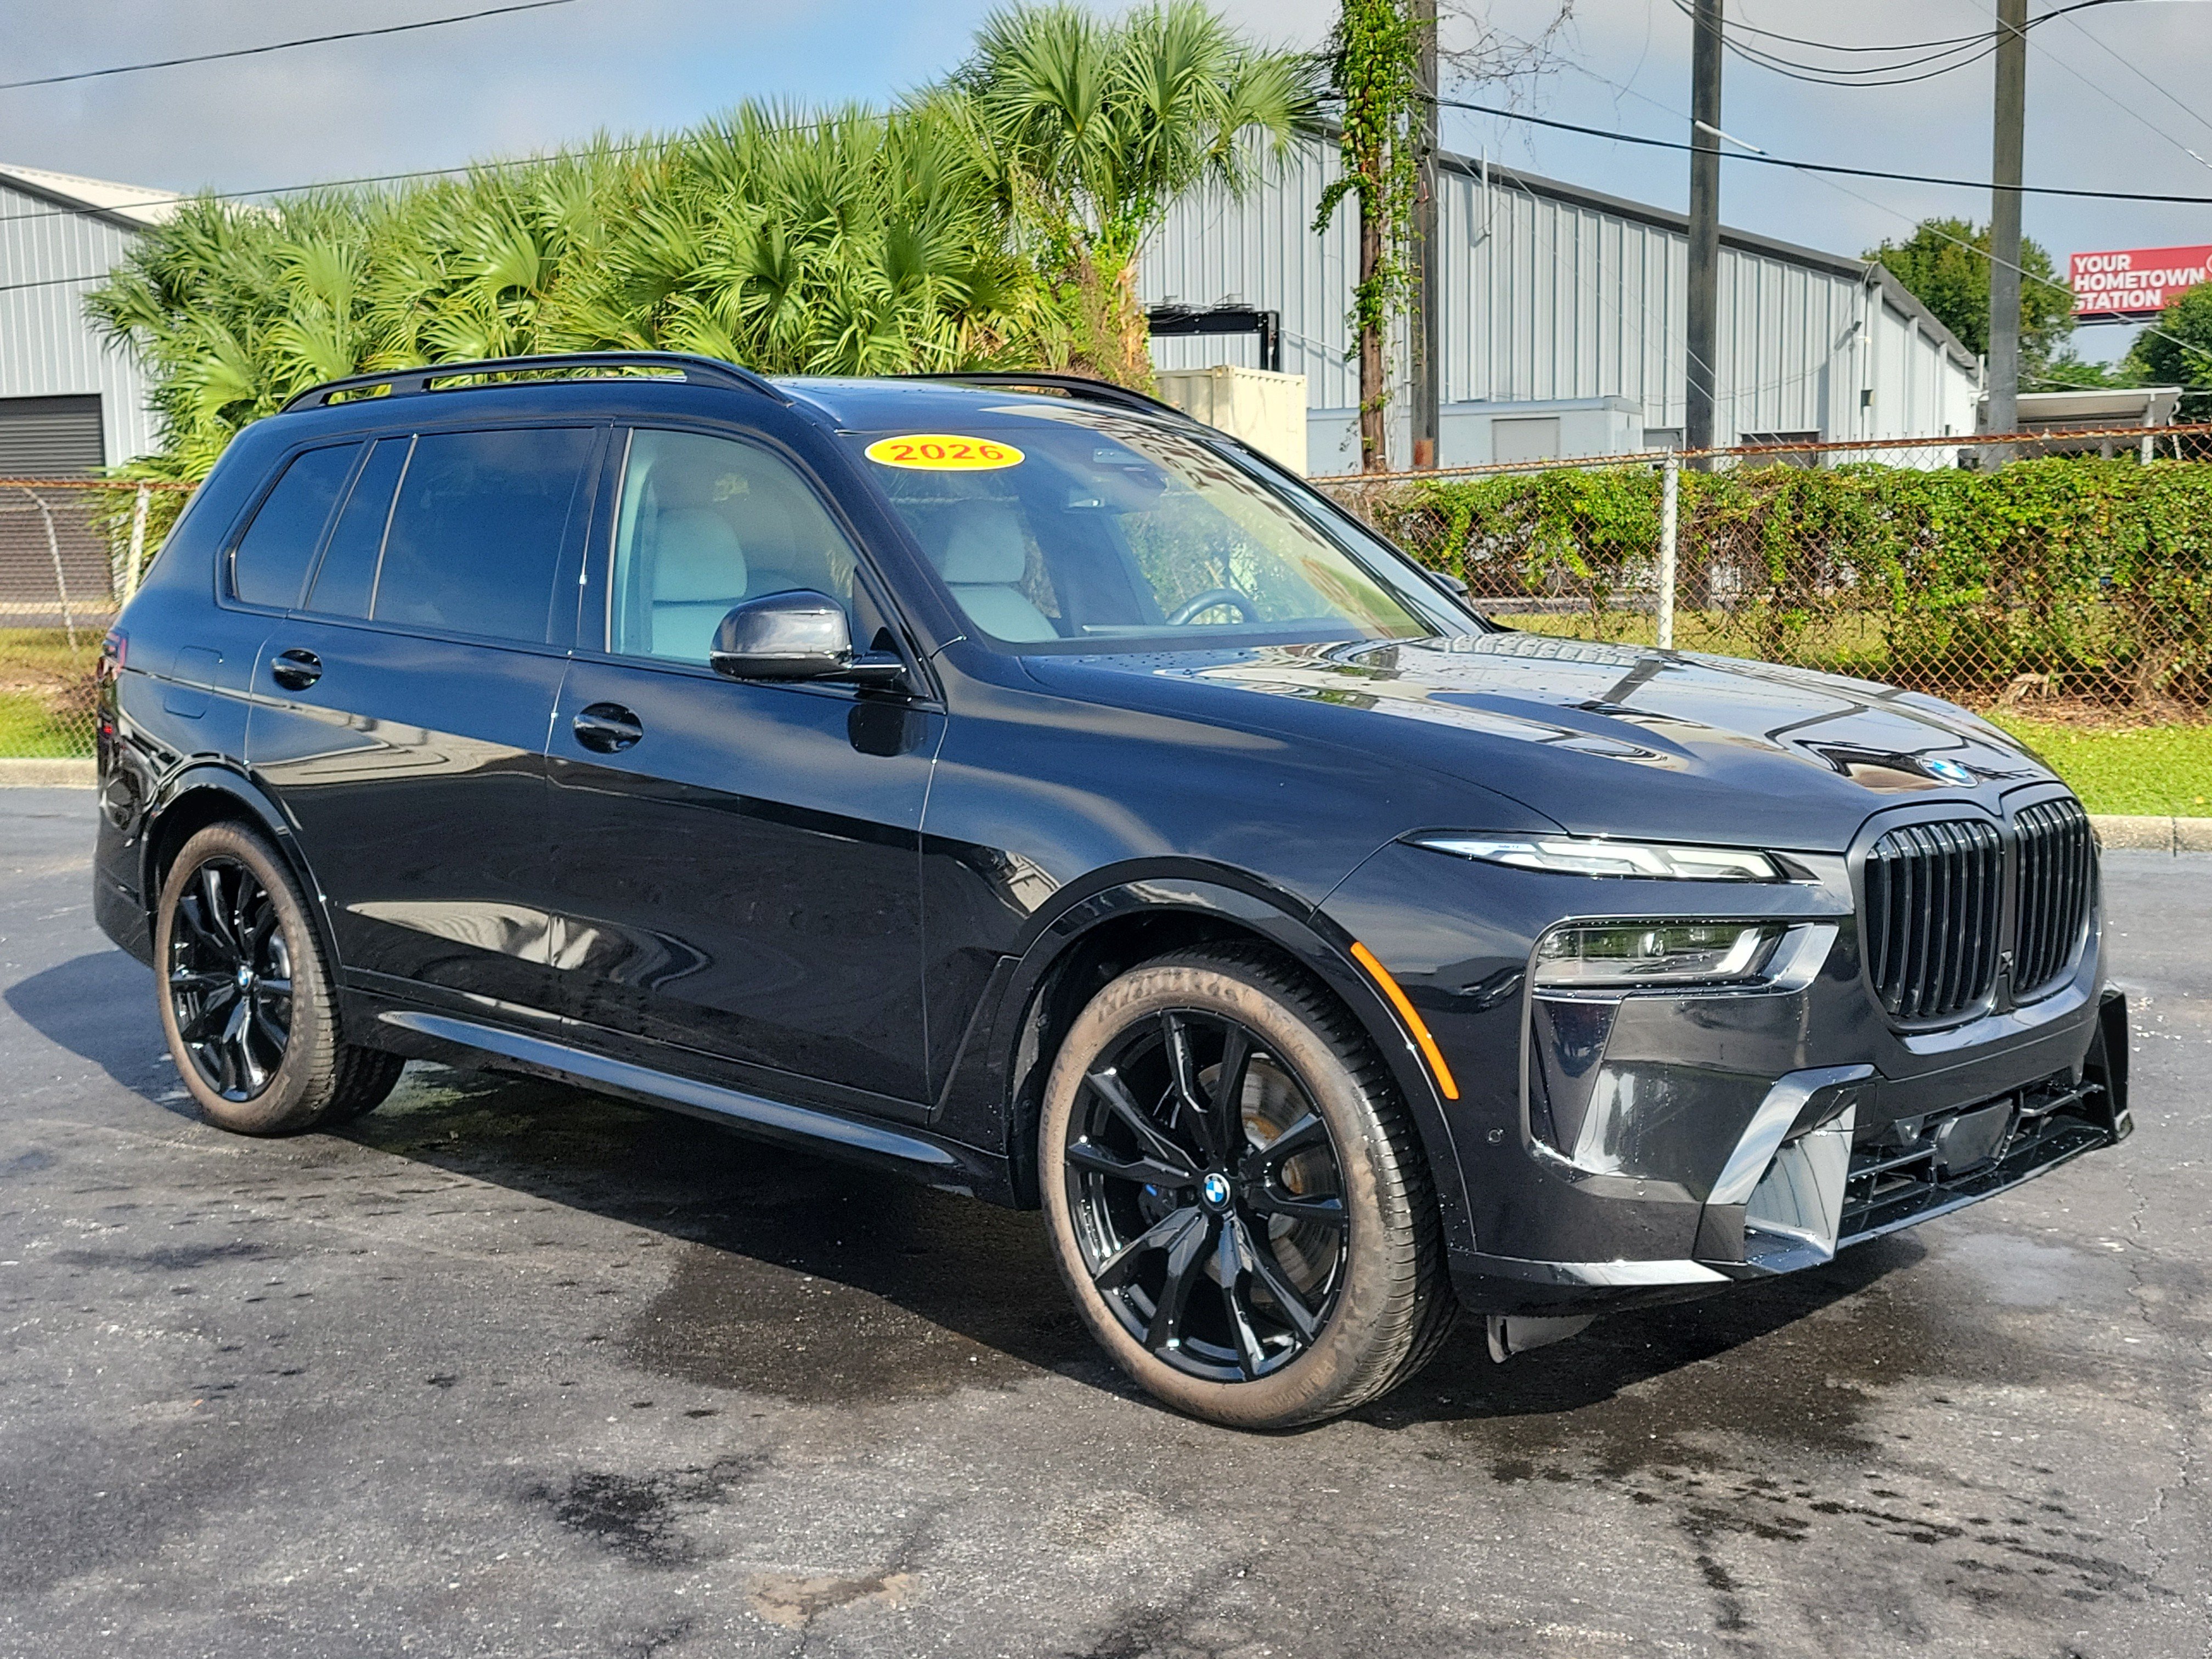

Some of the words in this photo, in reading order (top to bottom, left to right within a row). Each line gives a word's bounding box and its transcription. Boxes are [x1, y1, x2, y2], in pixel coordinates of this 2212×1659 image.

[2074, 254, 2132, 273] YOUR
[2074, 267, 2206, 292] HOMETOWN
[2072, 289, 2163, 311] STATION
[889, 444, 1005, 461] 2026
